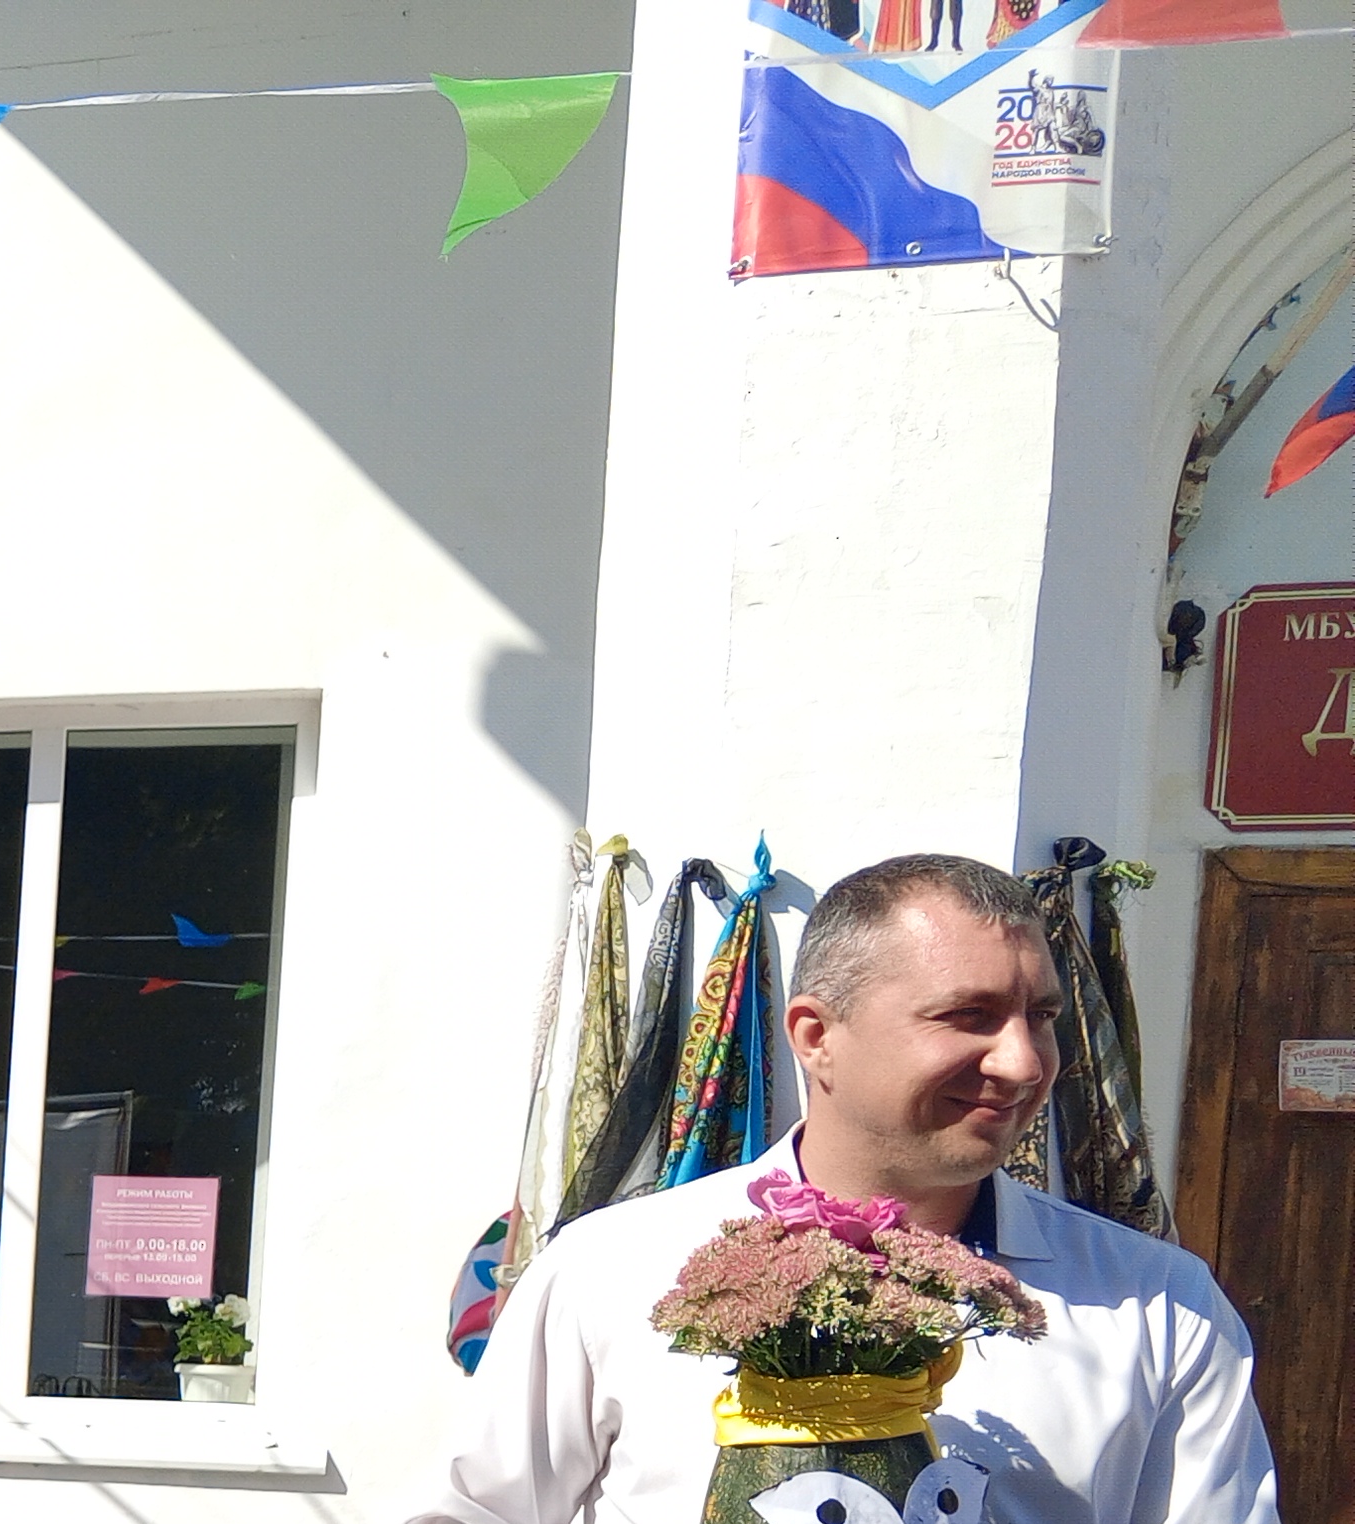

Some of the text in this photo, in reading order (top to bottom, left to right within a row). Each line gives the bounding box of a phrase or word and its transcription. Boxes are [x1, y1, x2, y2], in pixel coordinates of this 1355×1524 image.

[996, 94, 1037, 123] 20
[994, 123, 1033, 151] 26
[992, 158, 1072, 171] ГОД ЕДИНСТВА
[991, 167, 1086, 178] НАРОДОВ РОССИИ
[116, 1189, 193, 1199] РЕЖИМ РАБОТЫ
[96, 1239, 131, 1250] ПН-ПТ
[114, 1272, 130, 1283] ВС
[135, 1272, 203, 1285] ВЫХОДНОЙ
